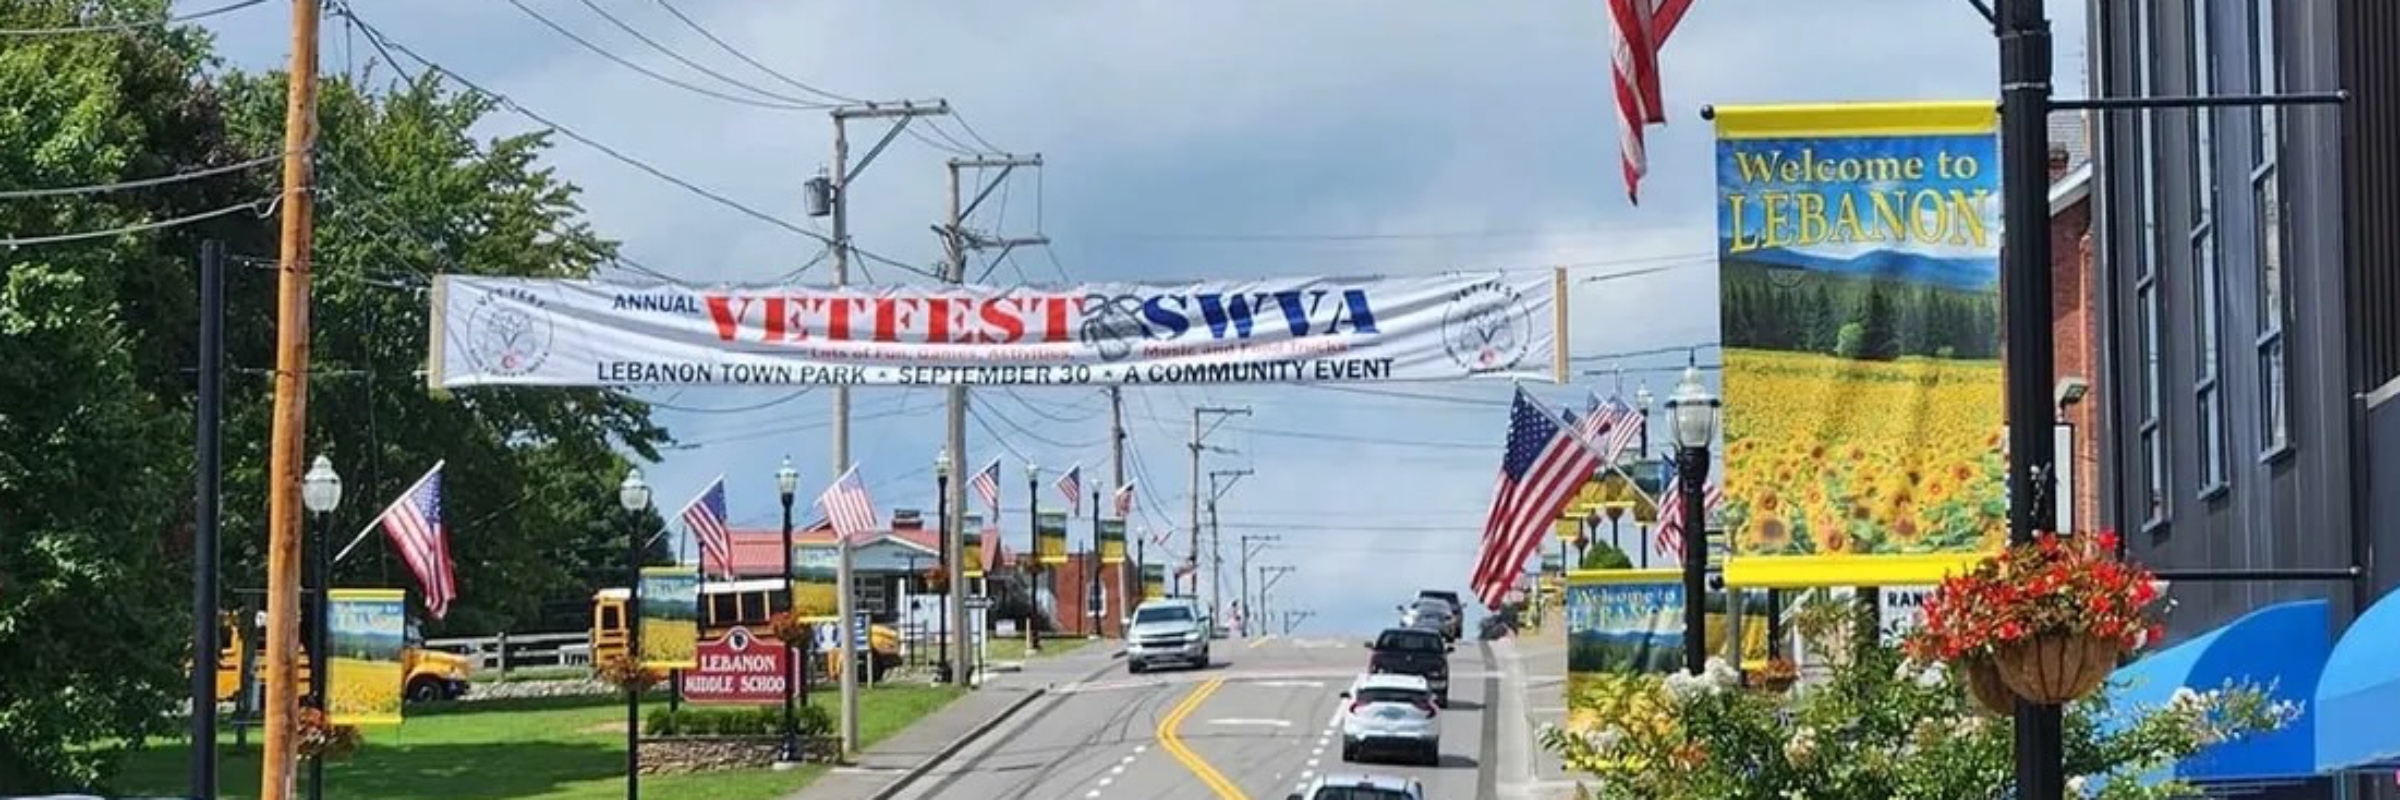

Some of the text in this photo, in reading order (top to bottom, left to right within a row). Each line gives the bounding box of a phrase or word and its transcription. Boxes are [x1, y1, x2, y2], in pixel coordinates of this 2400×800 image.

[1735, 148, 1978, 184] Welcome to
[1729, 188, 1989, 254] LEBANON
[613, 289, 1381, 343] ANNUAL VETFEST SWVA
[1143, 346, 1197, 359] Music
[597, 358, 1394, 385] LEBANON TOWN PARK SEPTEMBER 30 A COMMUNITY EVENT
[701, 654, 777, 673] LEBANON
[684, 674, 786, 693] MIDDLE SCHOO
